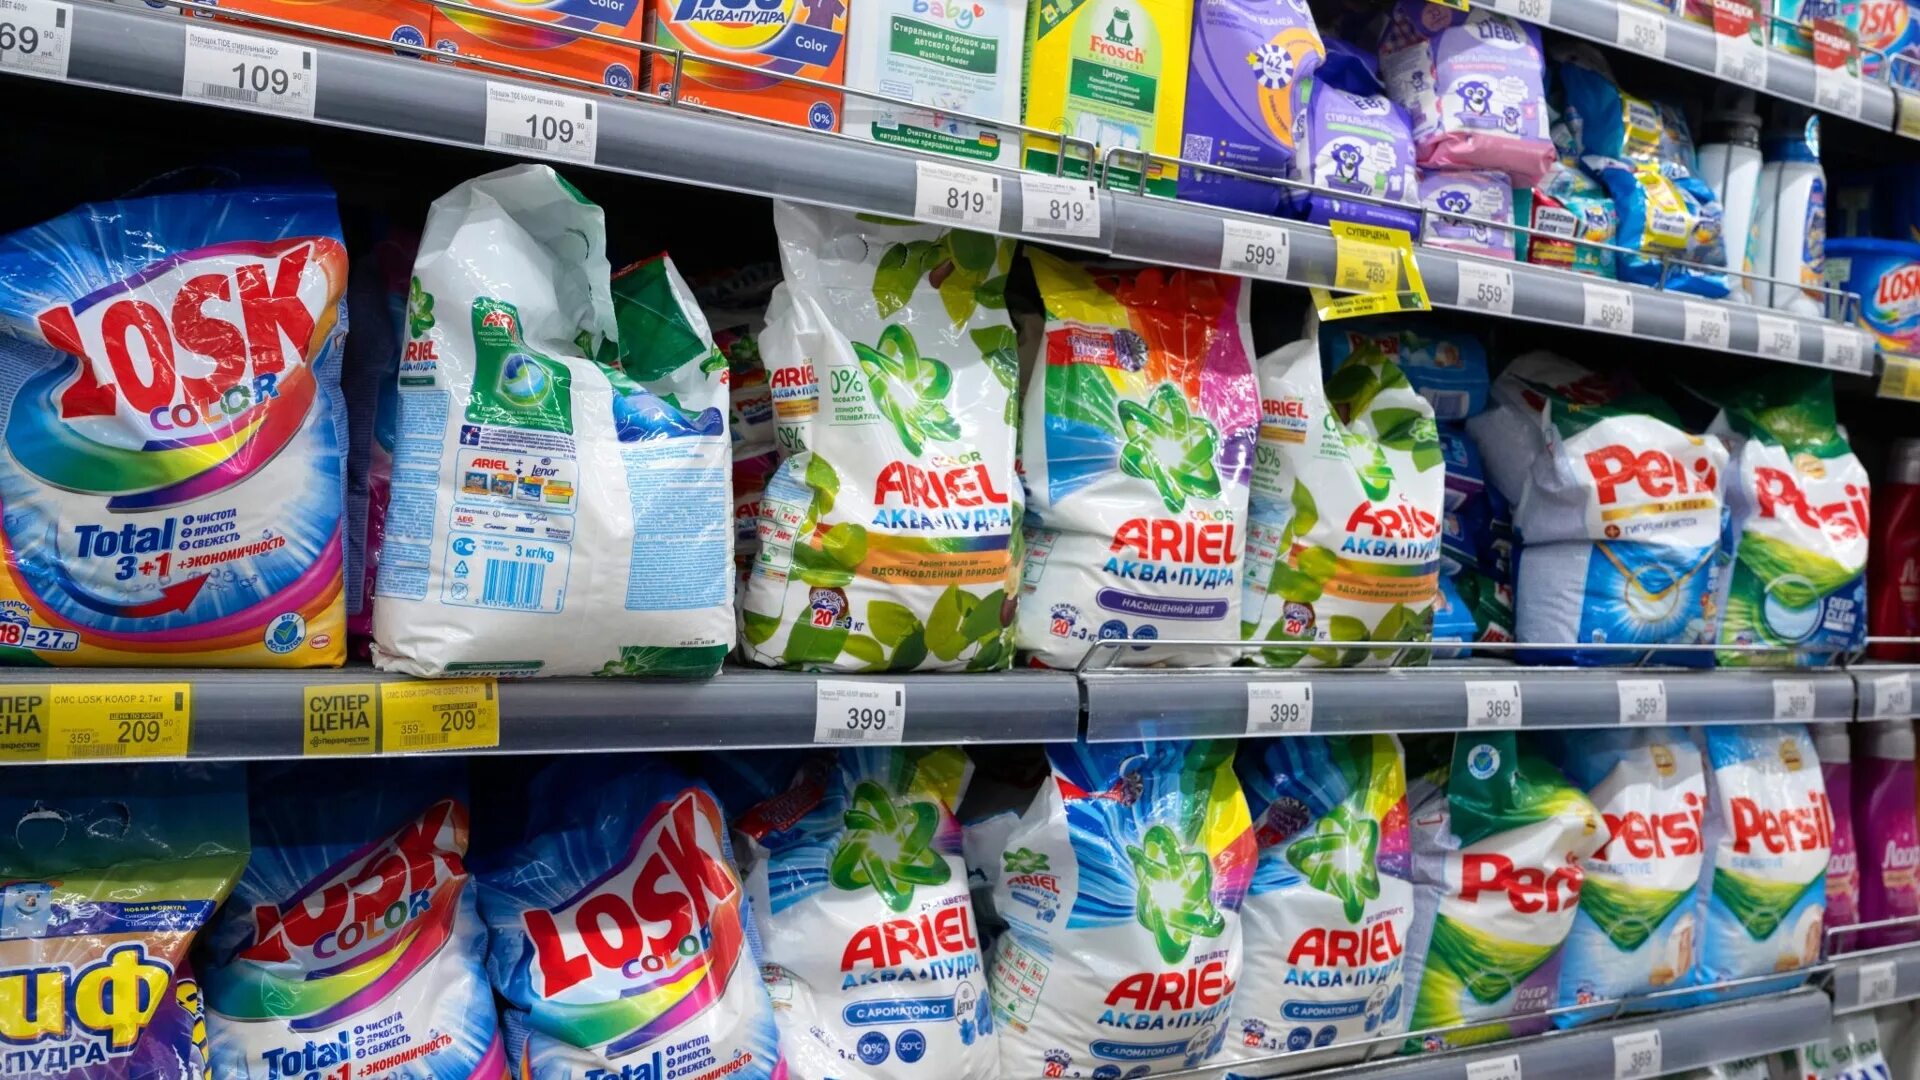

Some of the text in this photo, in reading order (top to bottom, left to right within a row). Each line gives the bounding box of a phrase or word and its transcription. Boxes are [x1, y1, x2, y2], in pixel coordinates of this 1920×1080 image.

[0, 22, 39, 54] 69
[795, 36, 828, 53] Color
[1089, 35, 1145, 64] Frosch
[1266, 55, 1282, 70] 42
[232, 62, 289, 95] 109
[609, 76, 627, 89] 0%
[1102, 68, 1129, 82] Цитрус
[813, 112, 830, 124] 0%
[526, 114, 574, 143] 109
[947, 188, 984, 213] 819
[1050, 199, 1083, 222] 819
[1346, 227, 1390, 241] СУПЕРЦЕНА
[1245, 244, 1275, 266] 599
[1366, 268, 1385, 284] 469
[1478, 284, 1501, 303] 559
[1601, 306, 1623, 323] 699
[38, 241, 315, 419] LOSK
[771, 364, 818, 388] ARIEL
[831, 370, 864, 395] 0%
[150, 372, 280, 431] COLOR
[1262, 400, 1308, 419] ARIEL
[471, 457, 510, 471] ARIEL
[531, 464, 560, 477] Lenor
[874, 461, 1009, 510] ARIEL
[196, 508, 237, 524] ЧИСТОТА
[872, 508, 935, 530] АКВА
[1190, 508, 1234, 521] COLOR
[74, 518, 177, 558] Total
[194, 521, 236, 536] ЯРКОСТЬ
[192, 532, 240, 550] СВЕЖЕСТЬ
[1109, 518, 1237, 565] ARIEL
[1341, 536, 1398, 559] АКВА
[177, 536, 286, 570] +ЭКОНОМИЧНОСТЬ
[515, 545, 555, 563] 3 кг/kg
[115, 552, 172, 581] 3+1
[872, 565, 964, 579] ВДОХНОВЛЕННЫЙ
[1103, 557, 1234, 590] АКВА ПУДРА
[1122, 598, 1215, 616] НАСЫЩЕННЫЙ ЦВЕТ
[1828, 597, 1854, 611] DEEP
[814, 609, 864, 631] 20 3 кг
[1053, 619, 1068, 634] 20
[1079, 628, 1087, 639] 3
[1286, 620, 1301, 634] 20
[0, 623, 21, 644] 18
[1104, 628, 1121, 640] 0%
[54, 695, 136, 705] СМС LOSK КОЛОР
[310, 694, 370, 712] СУПЕР
[1486, 700, 1511, 718] 369
[1635, 698, 1657, 716] 369
[310, 711, 370, 734] ЦЕНА
[441, 710, 476, 732] 209
[847, 708, 886, 731] 399
[1270, 703, 1299, 722] 399
[70, 733, 91, 744] 359
[117, 720, 160, 744] 209
[401, 725, 419, 735] 359
[1730, 790, 1834, 855] Persil
[1007, 874, 1061, 895] ARIEL
[523, 795, 736, 999] LOSK
[151, 904, 187, 912] ФОРМУЛА
[312, 889, 432, 960] COLOR
[841, 906, 977, 973] ARIEL
[1287, 920, 1403, 968] ARIEL
[621, 920, 713, 980] COLOR
[842, 966, 917, 991] АКВА
[931, 954, 981, 981] ПУДРА
[1283, 968, 1343, 987] АКВА
[1103, 962, 1237, 1012] ARIEL
[864, 1005, 930, 1018] АРОМАТОМ
[931, 1004, 946, 1015] ОТ
[956, 998, 976, 1018] Lenor
[1301, 1005, 1347, 1016] АРОМАТОМ
[1348, 1006, 1359, 1014] ОТ
[365, 1010, 403, 1032] ЧИСТОТА
[1097, 1009, 1164, 1031] АКВА
[366, 1023, 406, 1045] ЯРКОСТЬ
[677, 1034, 710, 1053] ЧИСТОТА
[1244, 1034, 1259, 1047] 20
[262, 1031, 350, 1079] Total
[357, 1033, 453, 1077] +ЭКОНОМИЧНОСТЬ
[367, 1034, 412, 1057] СВЕЖЕСТЬ
[862, 1042, 883, 1055] 0%
[1111, 1045, 1166, 1058] АРОМАТОМ
[1167, 1045, 1179, 1054] ОТ
[5, 1042, 106, 1074] ПУДРА
[677, 1047, 712, 1066] ЯРКОСТЬ
[677, 1055, 717, 1078] СВЕЖЕСТЬ
[1631, 1052, 1652, 1070] 369
[1046, 1063, 1062, 1078] 20
